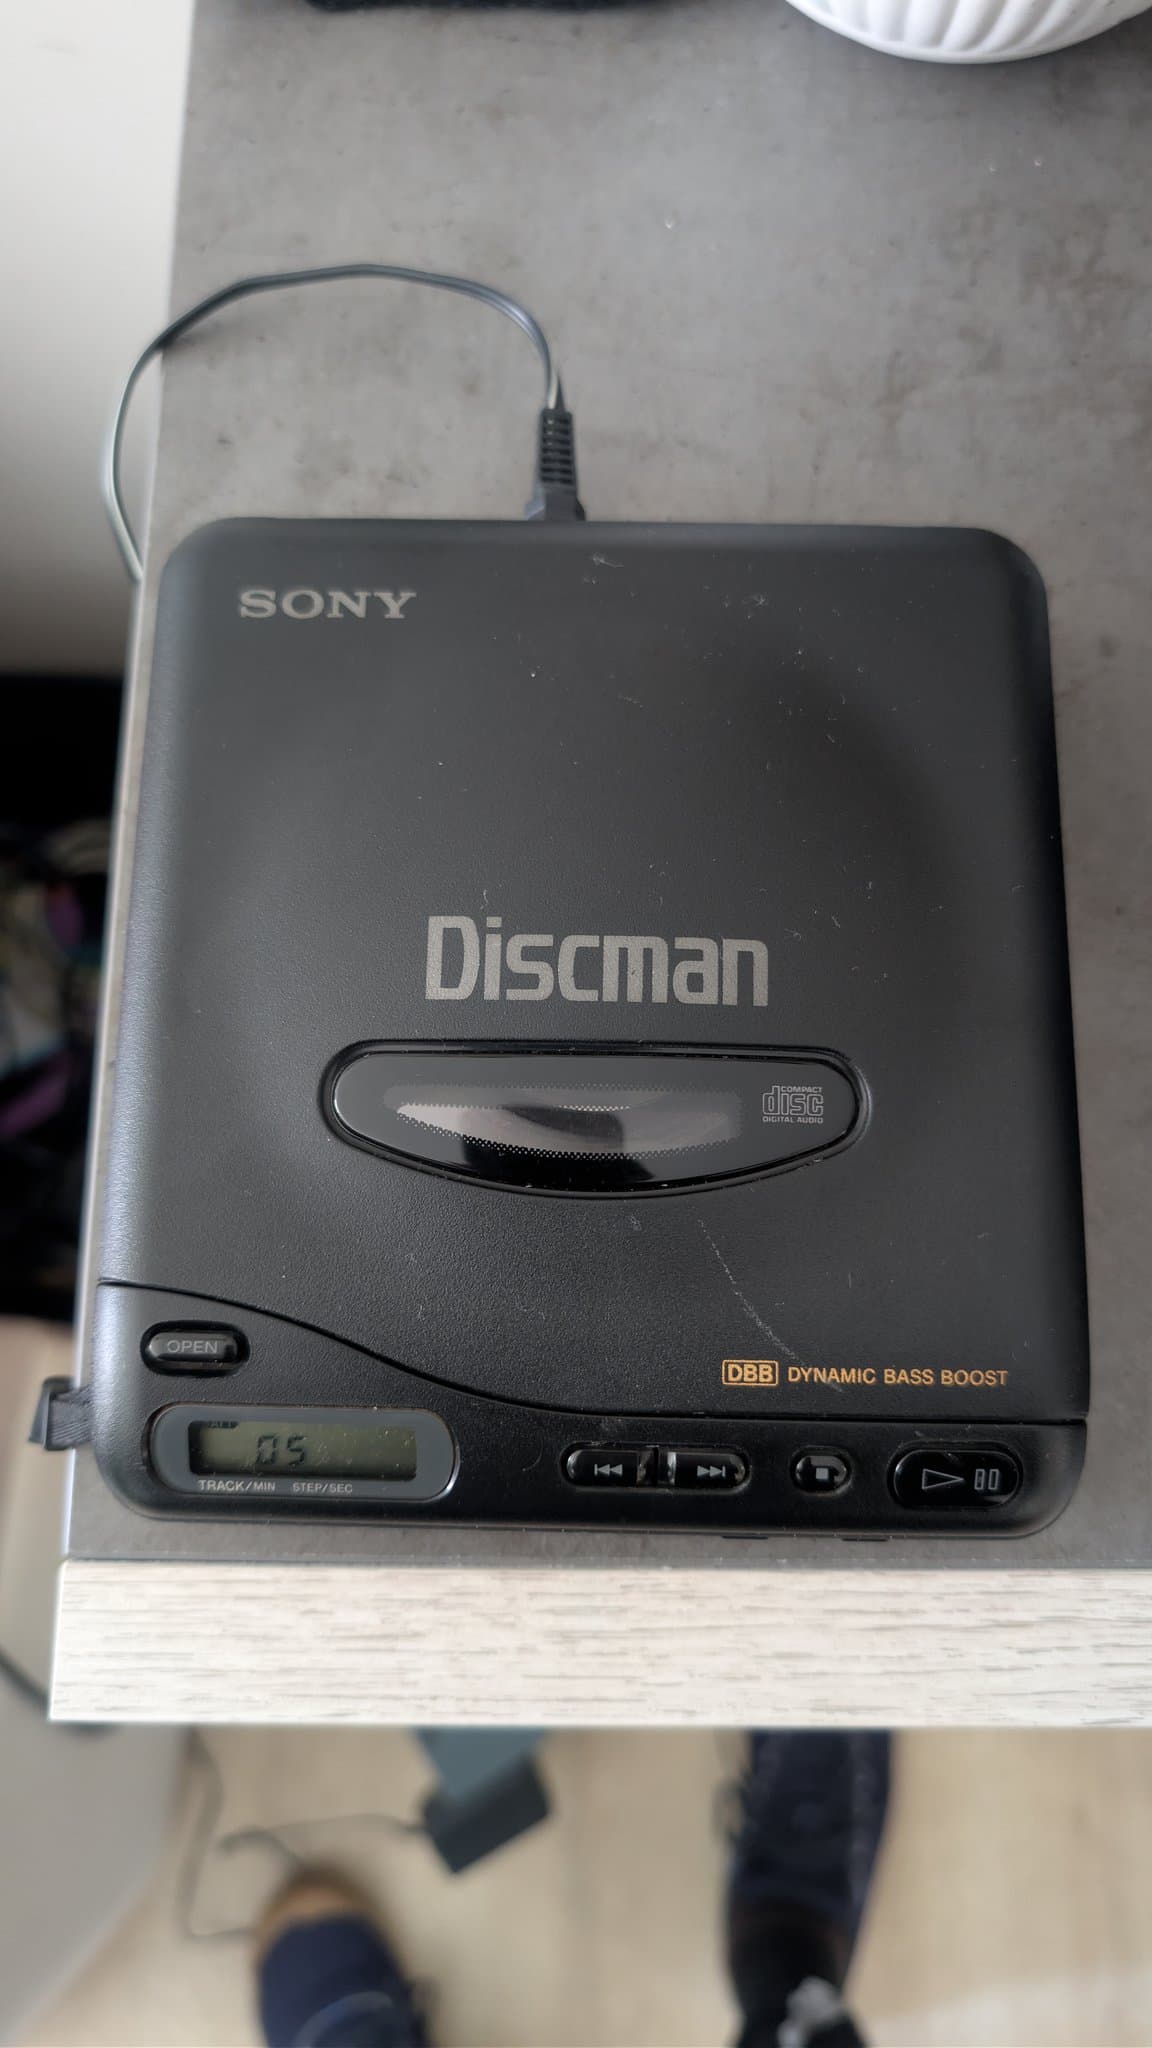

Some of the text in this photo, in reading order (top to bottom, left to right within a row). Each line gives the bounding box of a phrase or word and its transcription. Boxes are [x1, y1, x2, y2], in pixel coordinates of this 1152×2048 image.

[240, 589, 417, 619] SONY
[425, 915, 769, 1007] Discman
[762, 1085, 824, 1116] disc
[167, 1340, 218, 1353] OPEN
[727, 1363, 1008, 1386] DBB DYNAMIC BASS BOOST
[257, 1434, 305, 1466] 05
[199, 1480, 353, 1493] TRACK/MIN STEP/SEC
